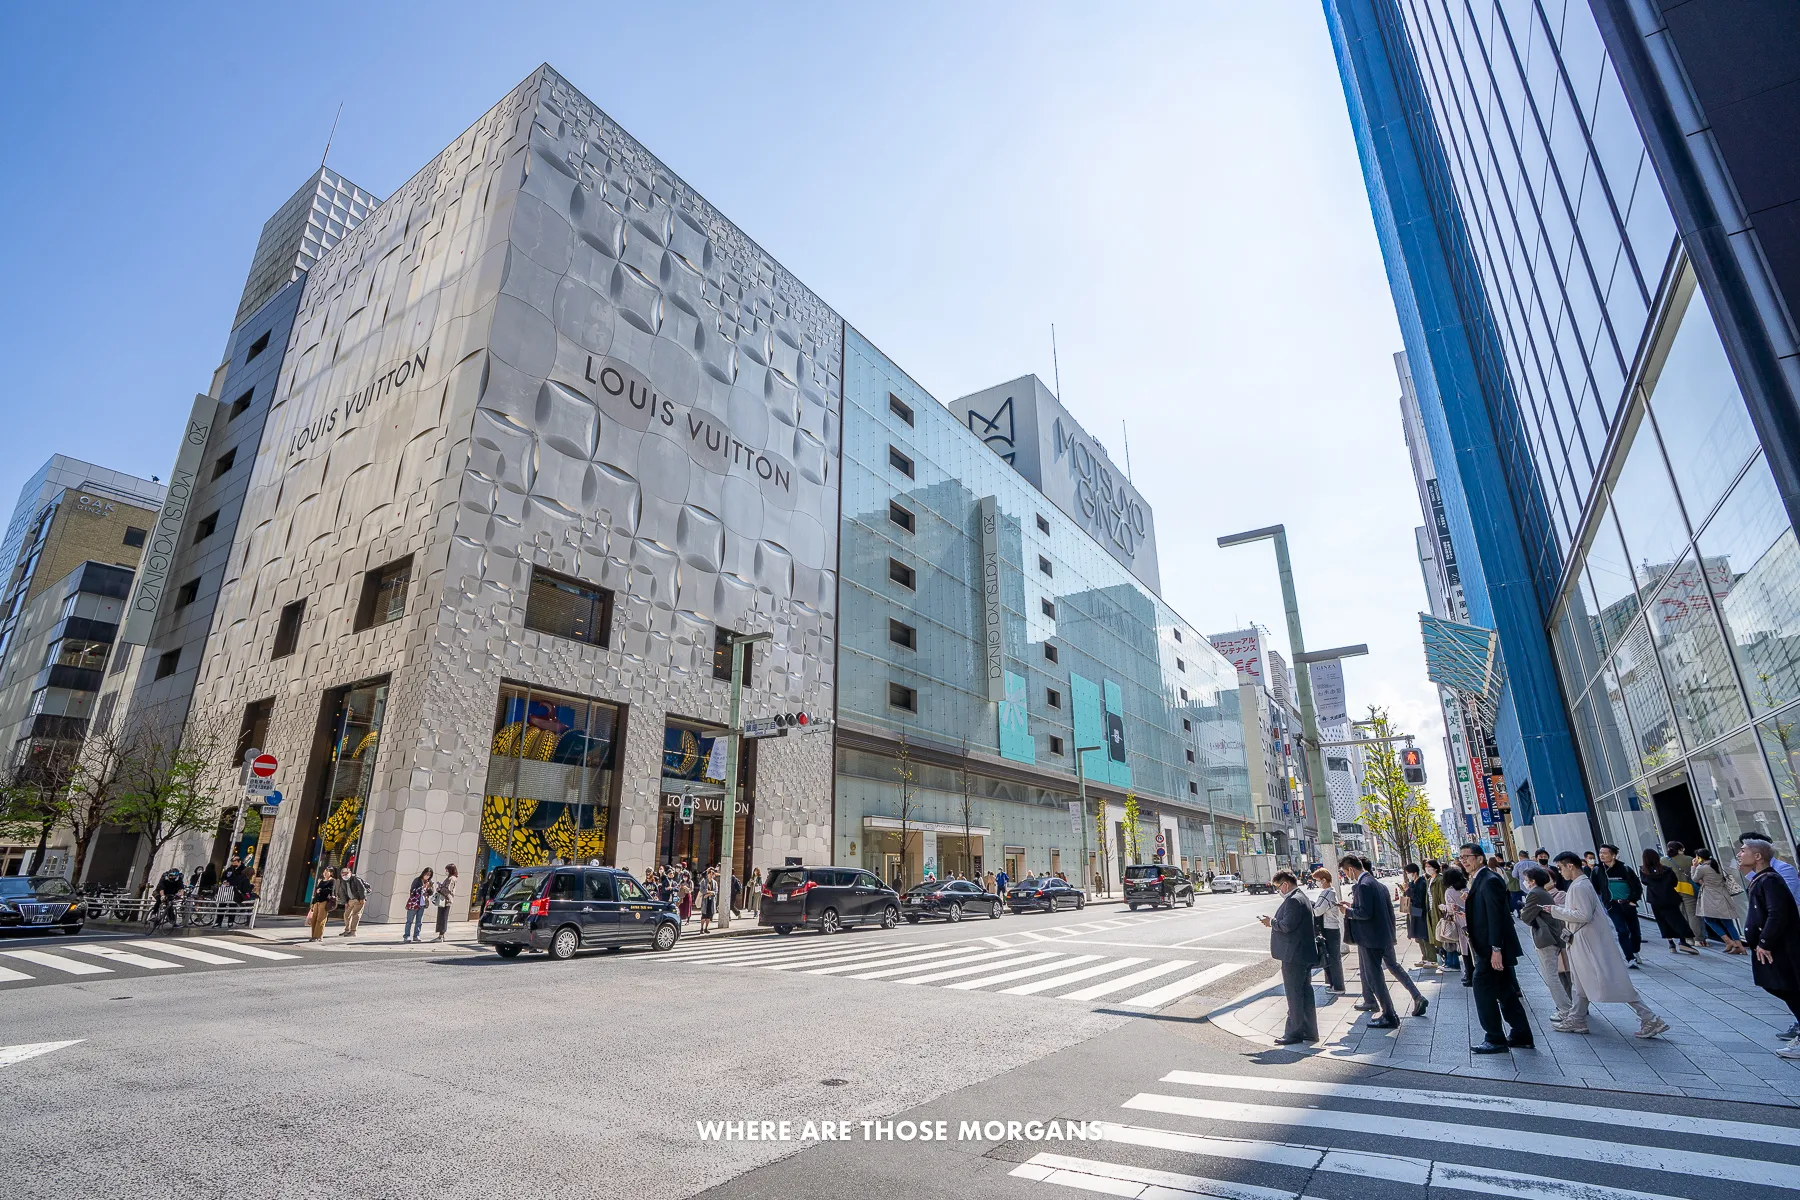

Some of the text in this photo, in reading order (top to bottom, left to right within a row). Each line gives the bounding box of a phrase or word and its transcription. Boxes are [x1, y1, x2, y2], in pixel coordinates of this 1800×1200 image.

[289, 346, 430, 457] LOUIS VUITTON
[584, 355, 790, 493] LOUIS VUITTON
[77, 504, 108, 517] GINZA
[80, 495, 116, 513] OAK
[1213, 636, 1256, 650] リニューアル
[1458, 768, 1468, 780] 本
[704, 798, 750, 815] VUION
[1486, 777, 1500, 819] CHAUMET
